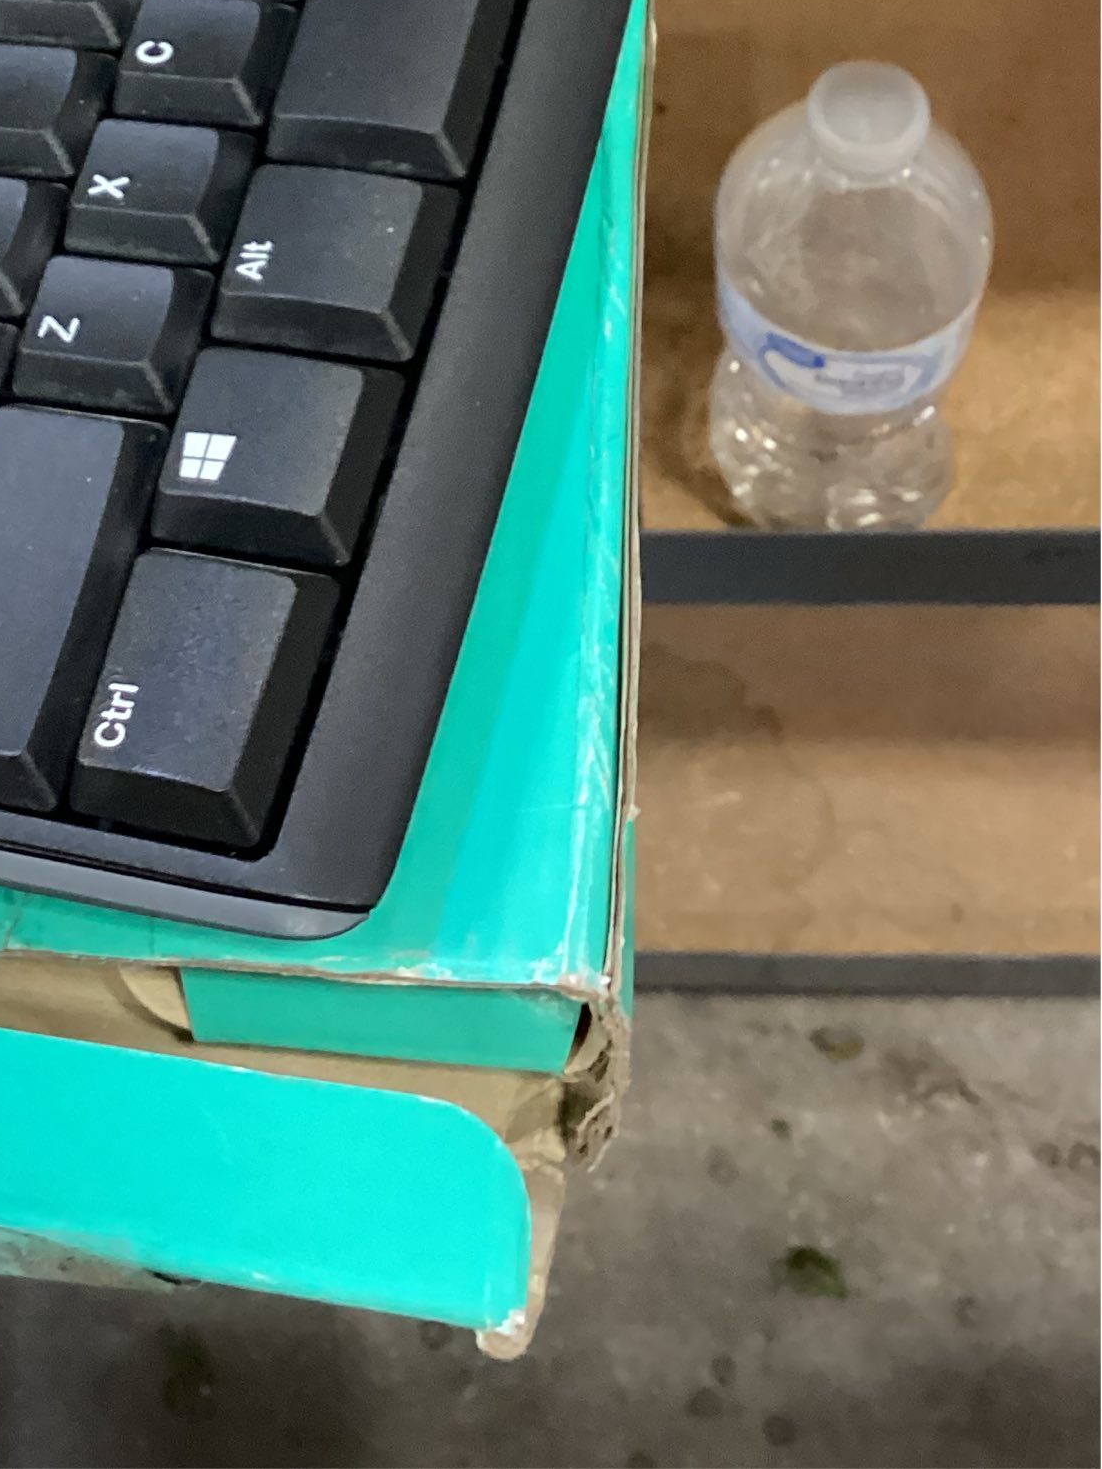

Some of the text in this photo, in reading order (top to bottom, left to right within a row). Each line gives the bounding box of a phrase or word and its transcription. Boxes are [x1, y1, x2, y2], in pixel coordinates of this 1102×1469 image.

[136, 41, 173, 64] C
[88, 175, 129, 198] X
[236, 241, 272, 281] Alt
[38, 316, 79, 342] Z
[94, 683, 139, 747] Ctrl
